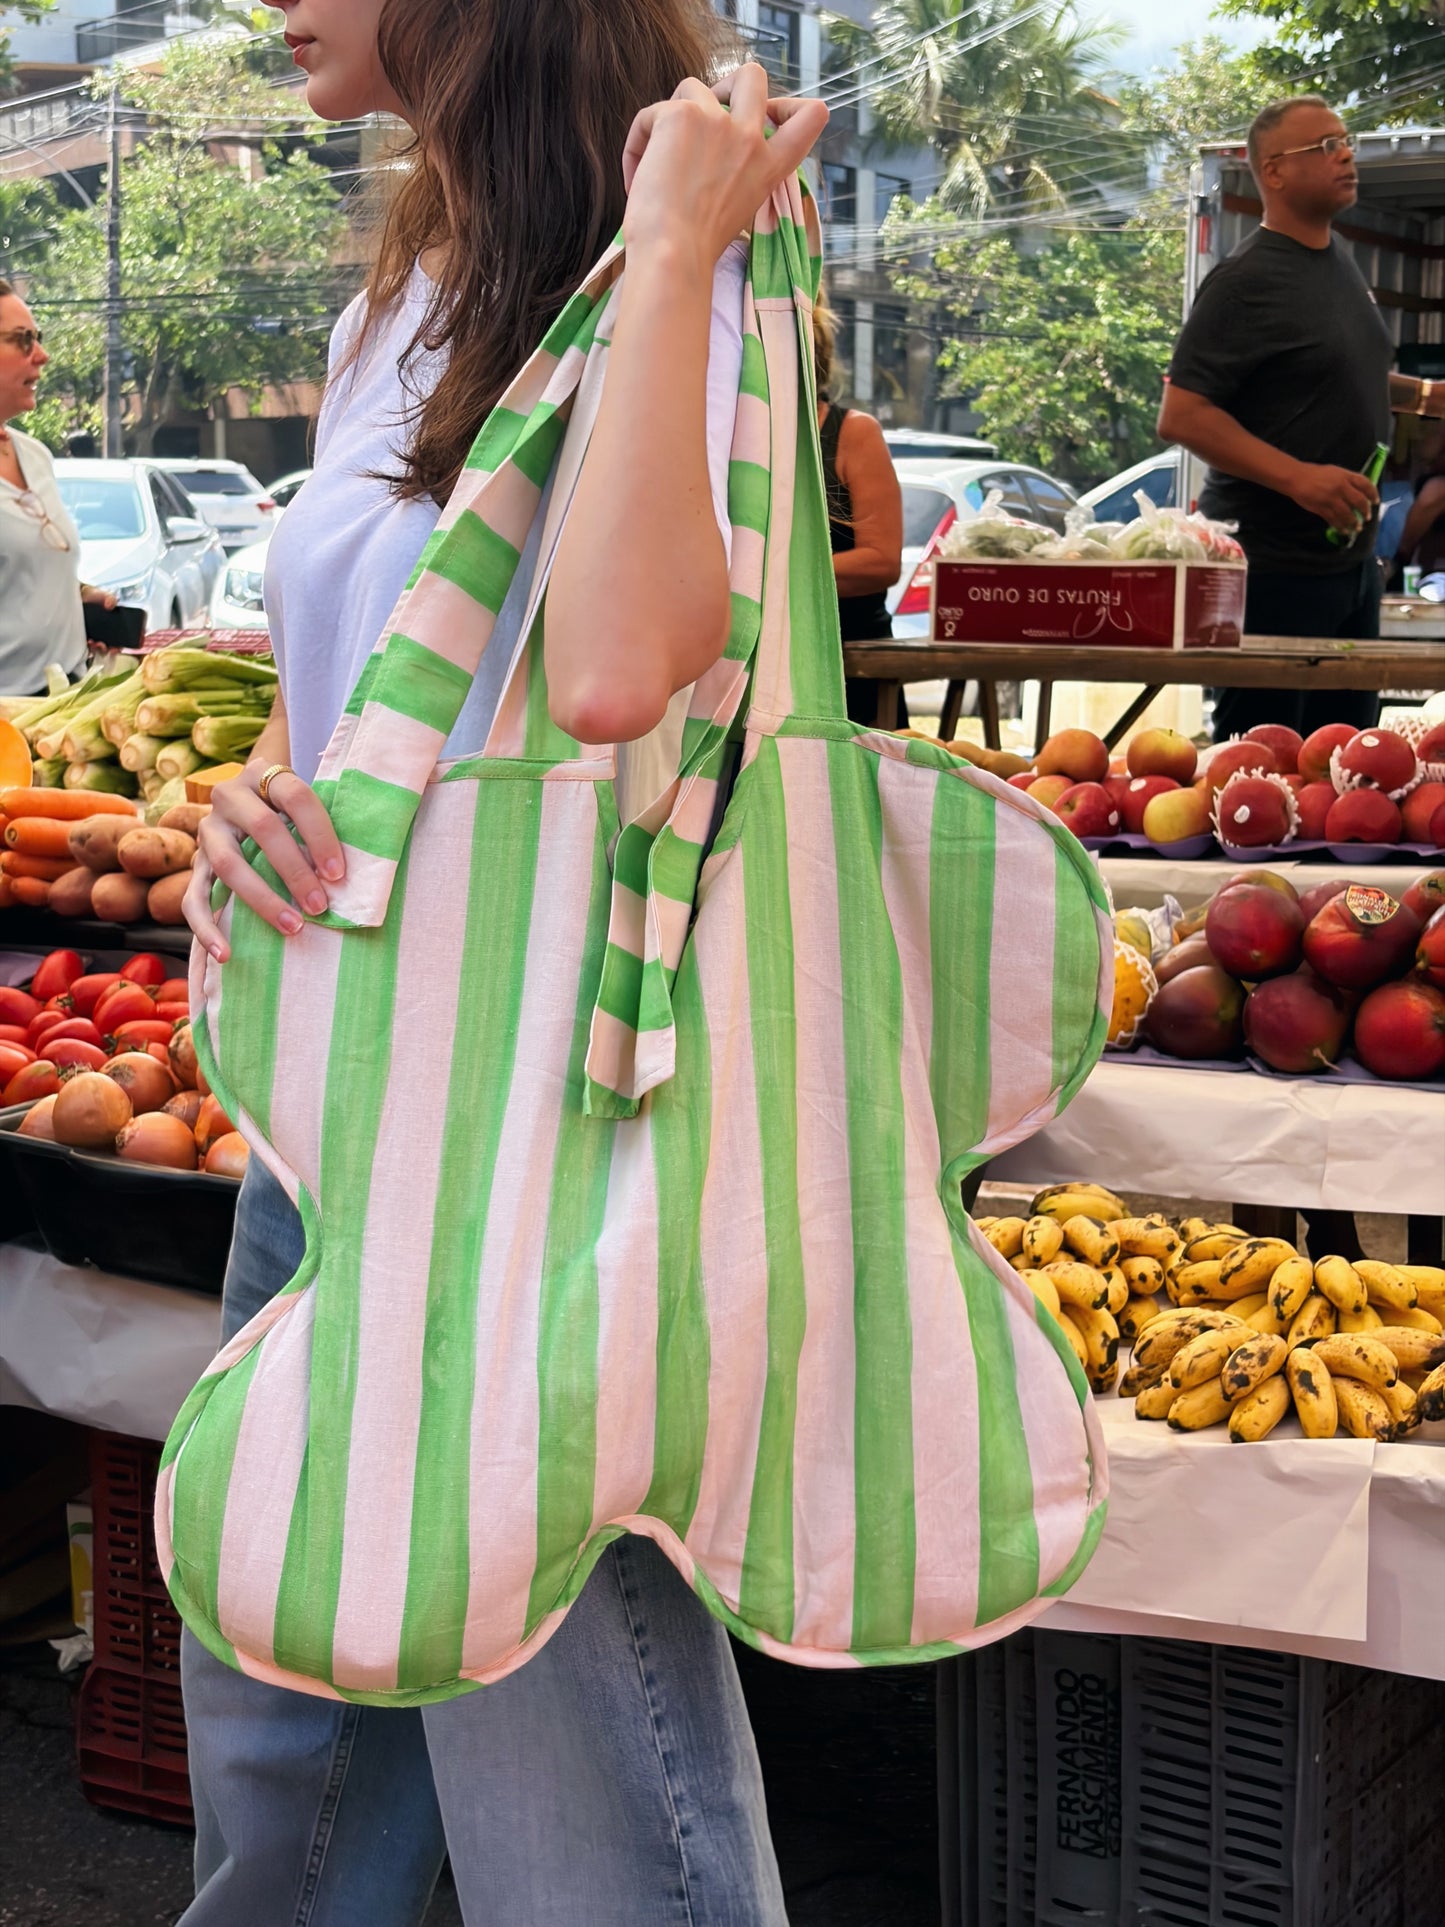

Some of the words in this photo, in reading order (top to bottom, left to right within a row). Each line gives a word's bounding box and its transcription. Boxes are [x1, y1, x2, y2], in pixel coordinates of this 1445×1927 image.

[968, 586, 1019, 603] OURO
[1028, 588, 1049, 602] DE
[1057, 587, 1121, 606] FRUTAS
[1055, 1668, 1080, 1852] FERNANDO
[1079, 1673, 1105, 1858] NASCIMENTO
